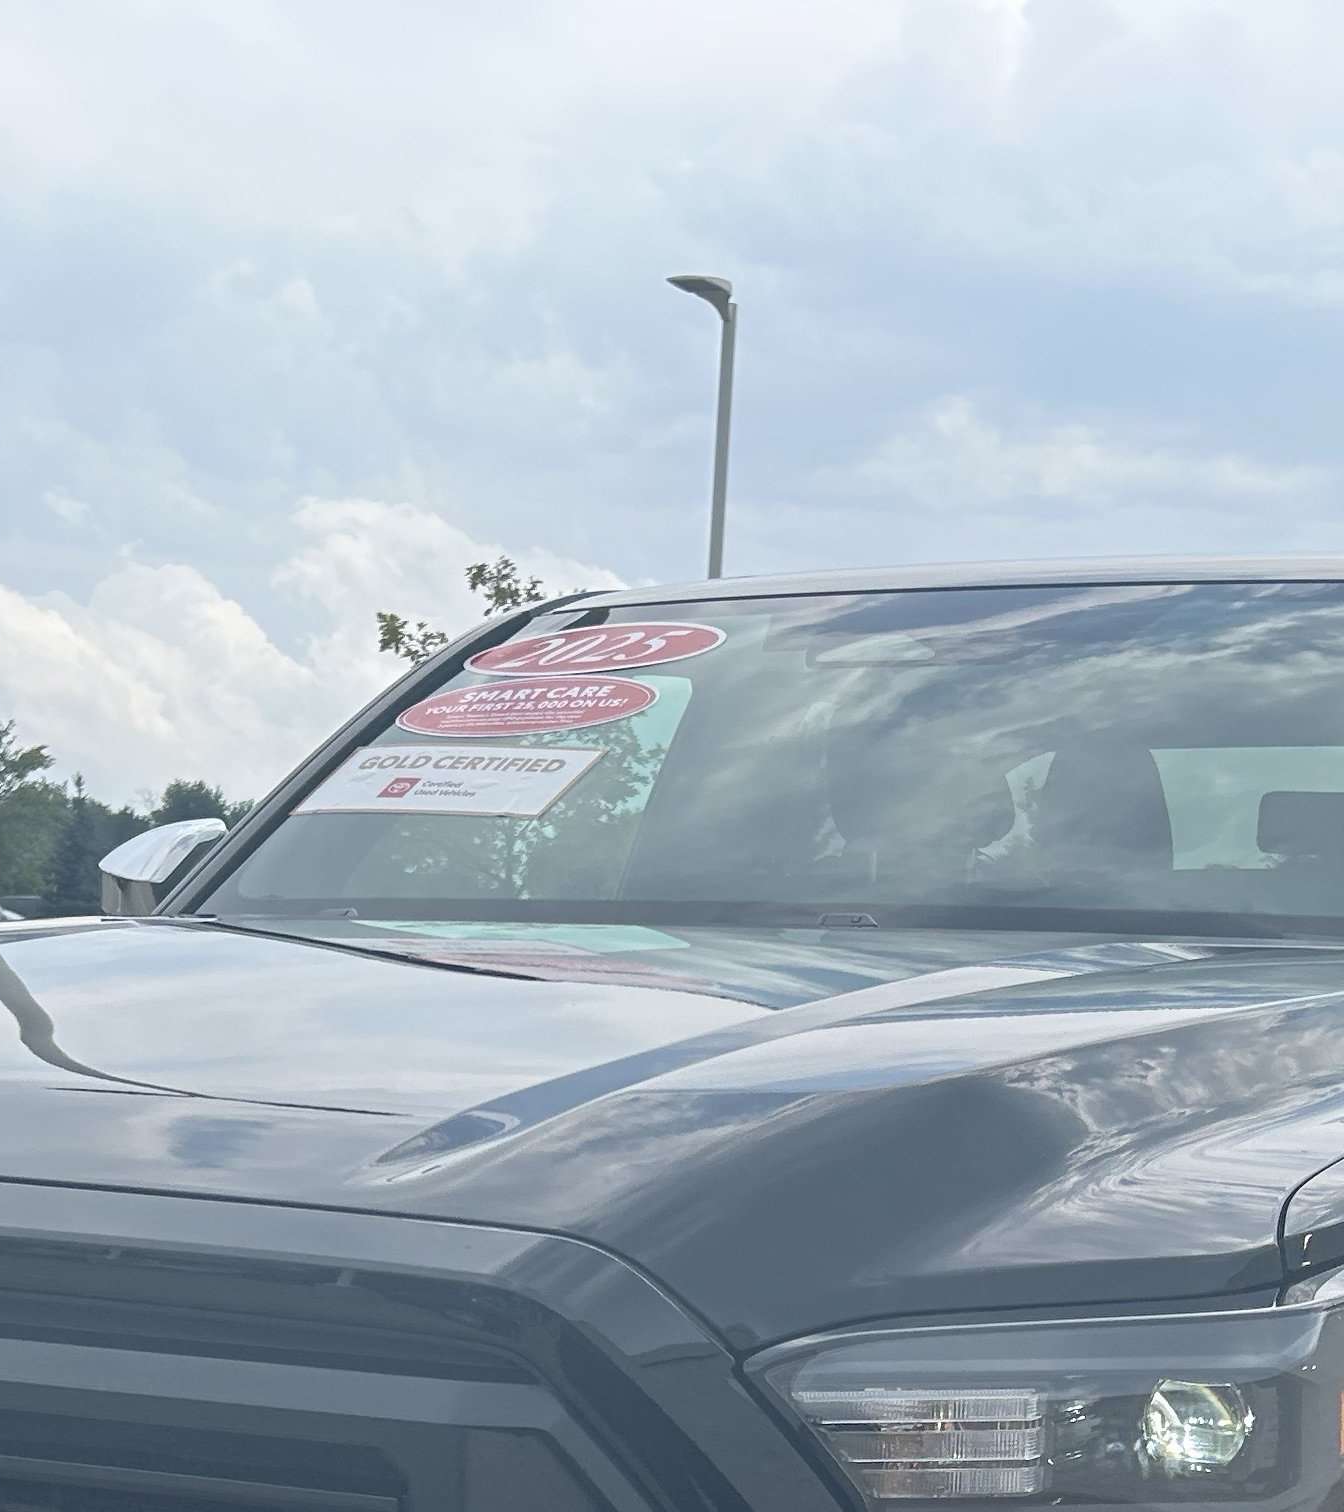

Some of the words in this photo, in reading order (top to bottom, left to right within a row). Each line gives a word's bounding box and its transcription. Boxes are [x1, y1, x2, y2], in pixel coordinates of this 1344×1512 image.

[490, 630, 694, 669] 2025
[459, 687, 547, 704] SMART
[547, 685, 616, 699] CARE
[425, 704, 466, 715] YOUR
[468, 702, 515, 712] FIRST
[569, 699, 598, 708] ON
[598, 698, 629, 707] US!
[358, 756, 432, 770] GOLD
[432, 756, 566, 773] CERTIFIED
[414, 788, 436, 796] Used
[439, 789, 476, 797] Vehicles
[421, 780, 463, 788] Certified
